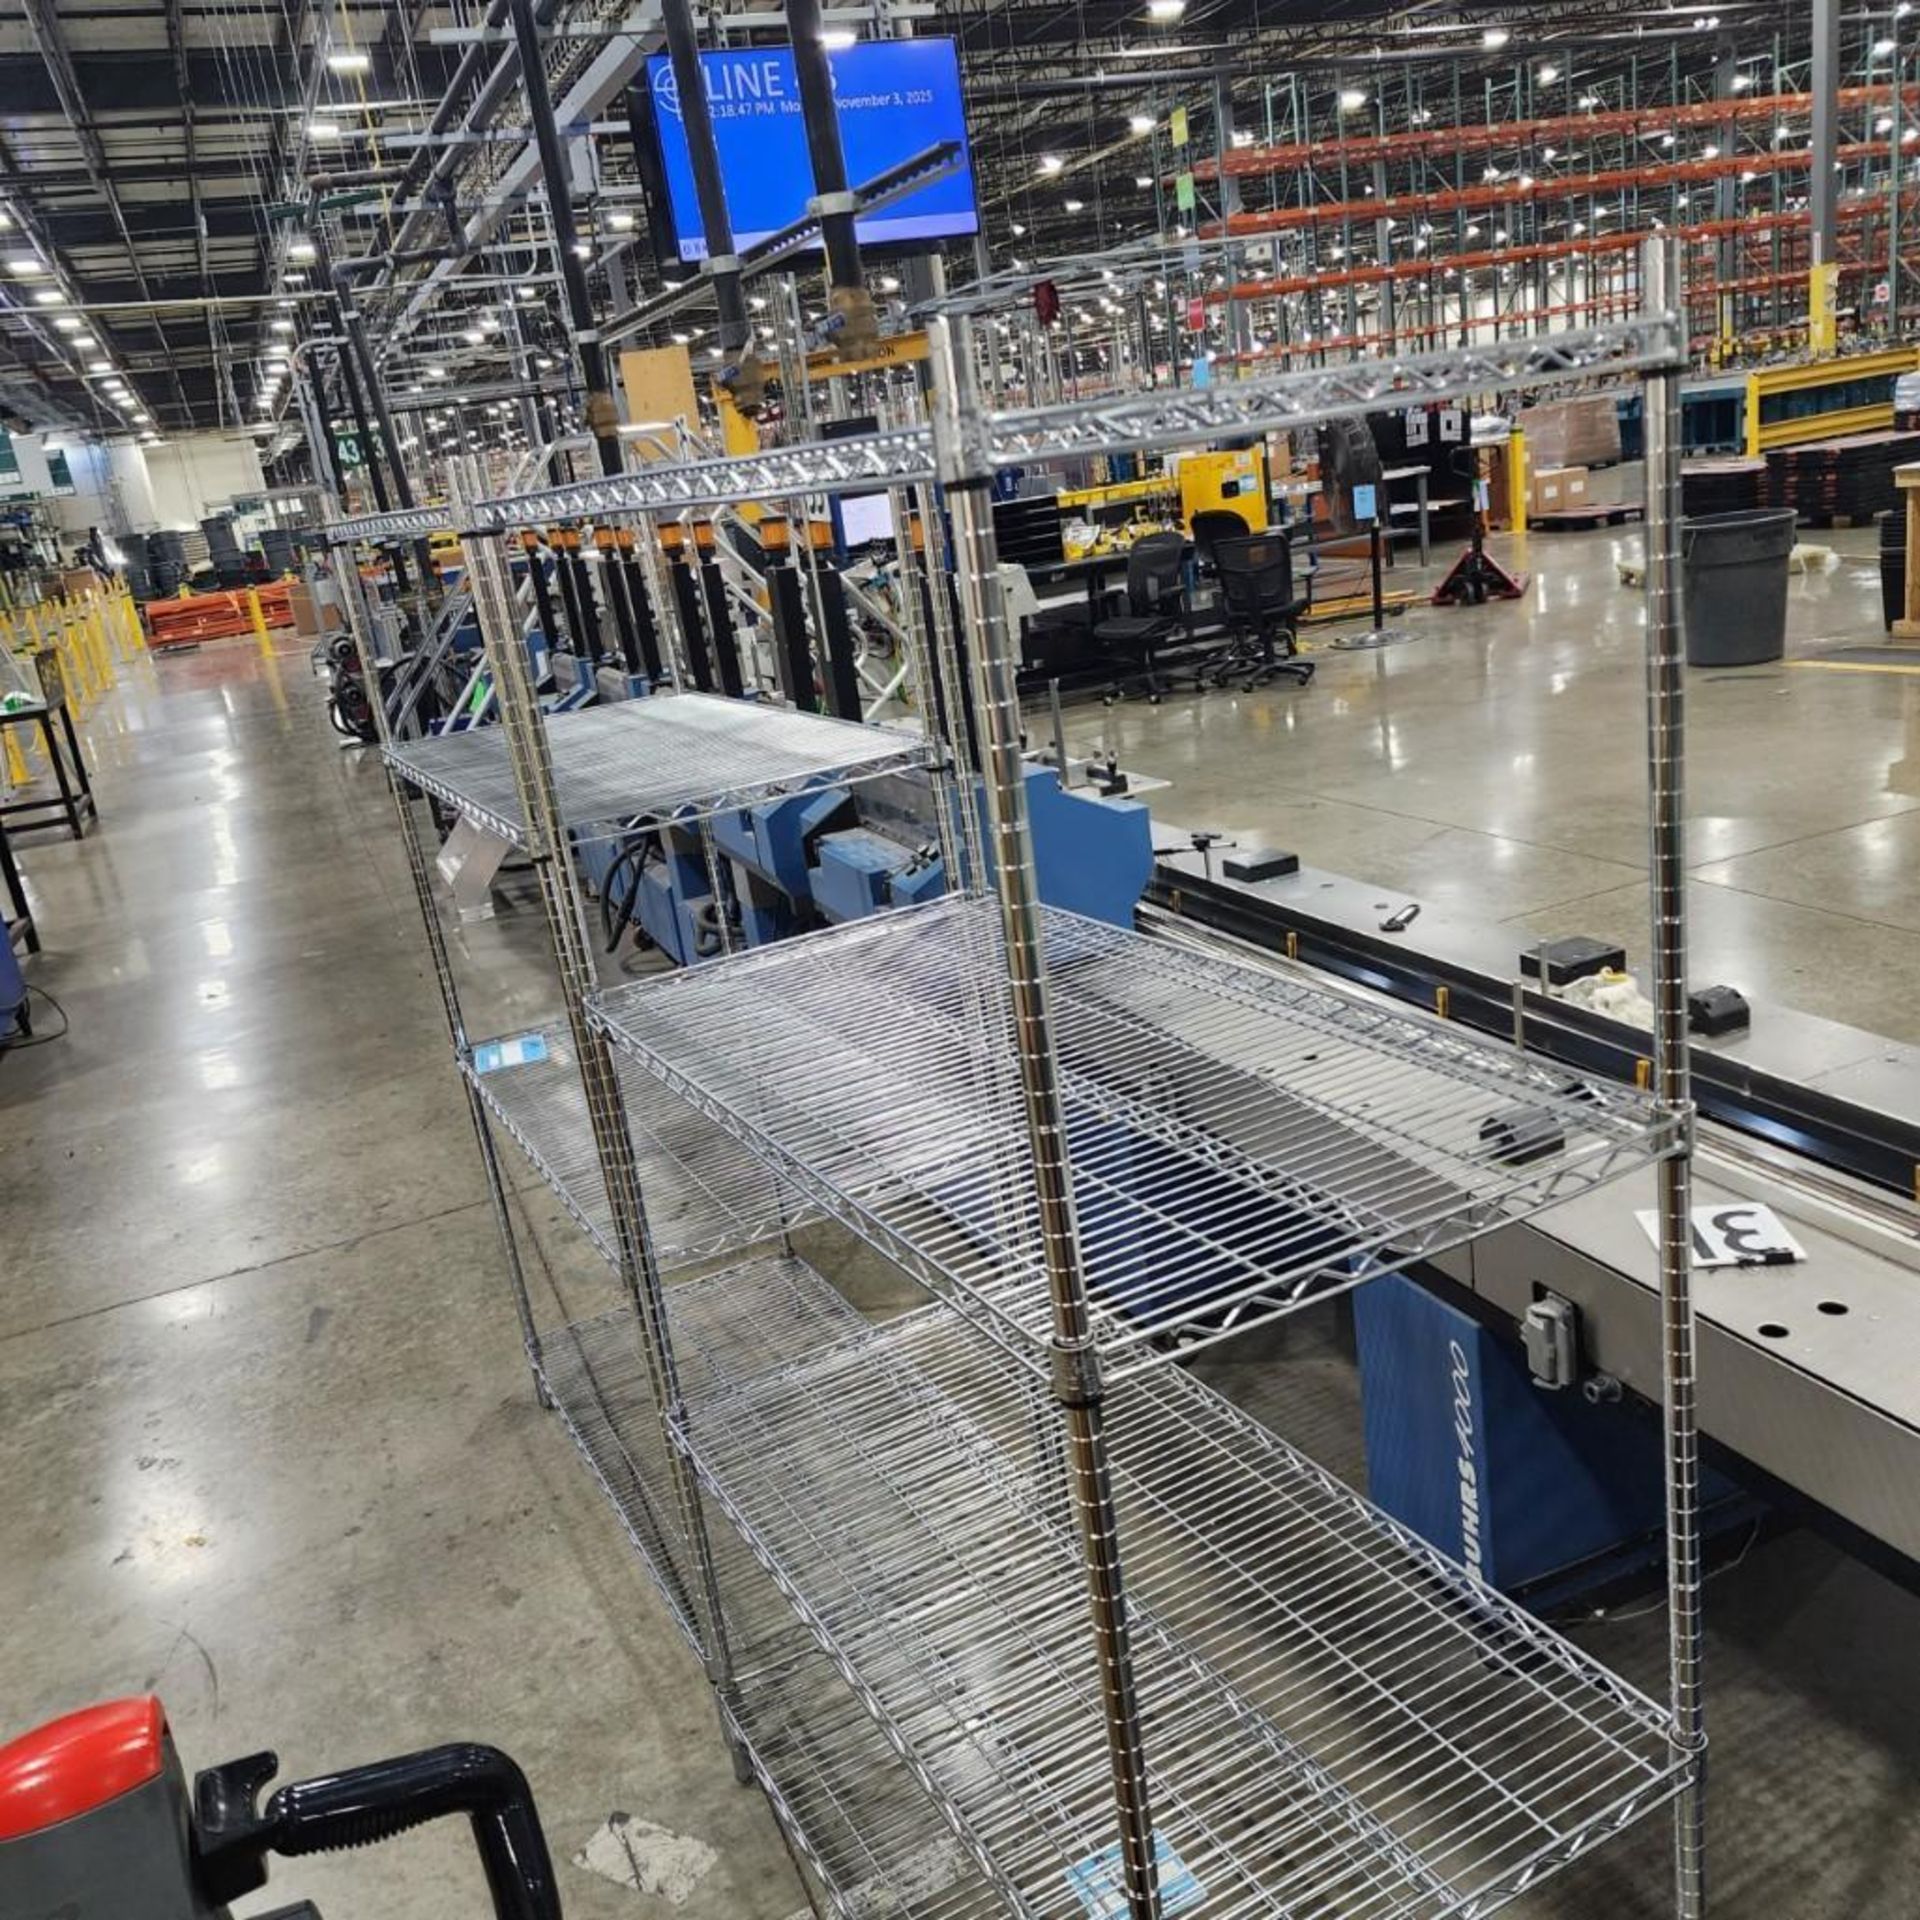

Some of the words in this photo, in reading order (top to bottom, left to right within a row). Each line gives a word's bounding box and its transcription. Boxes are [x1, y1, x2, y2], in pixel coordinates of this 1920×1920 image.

[703, 61, 784, 101] LINE
[755, 101, 775, 116] PM
[338, 438, 361, 463] 43
